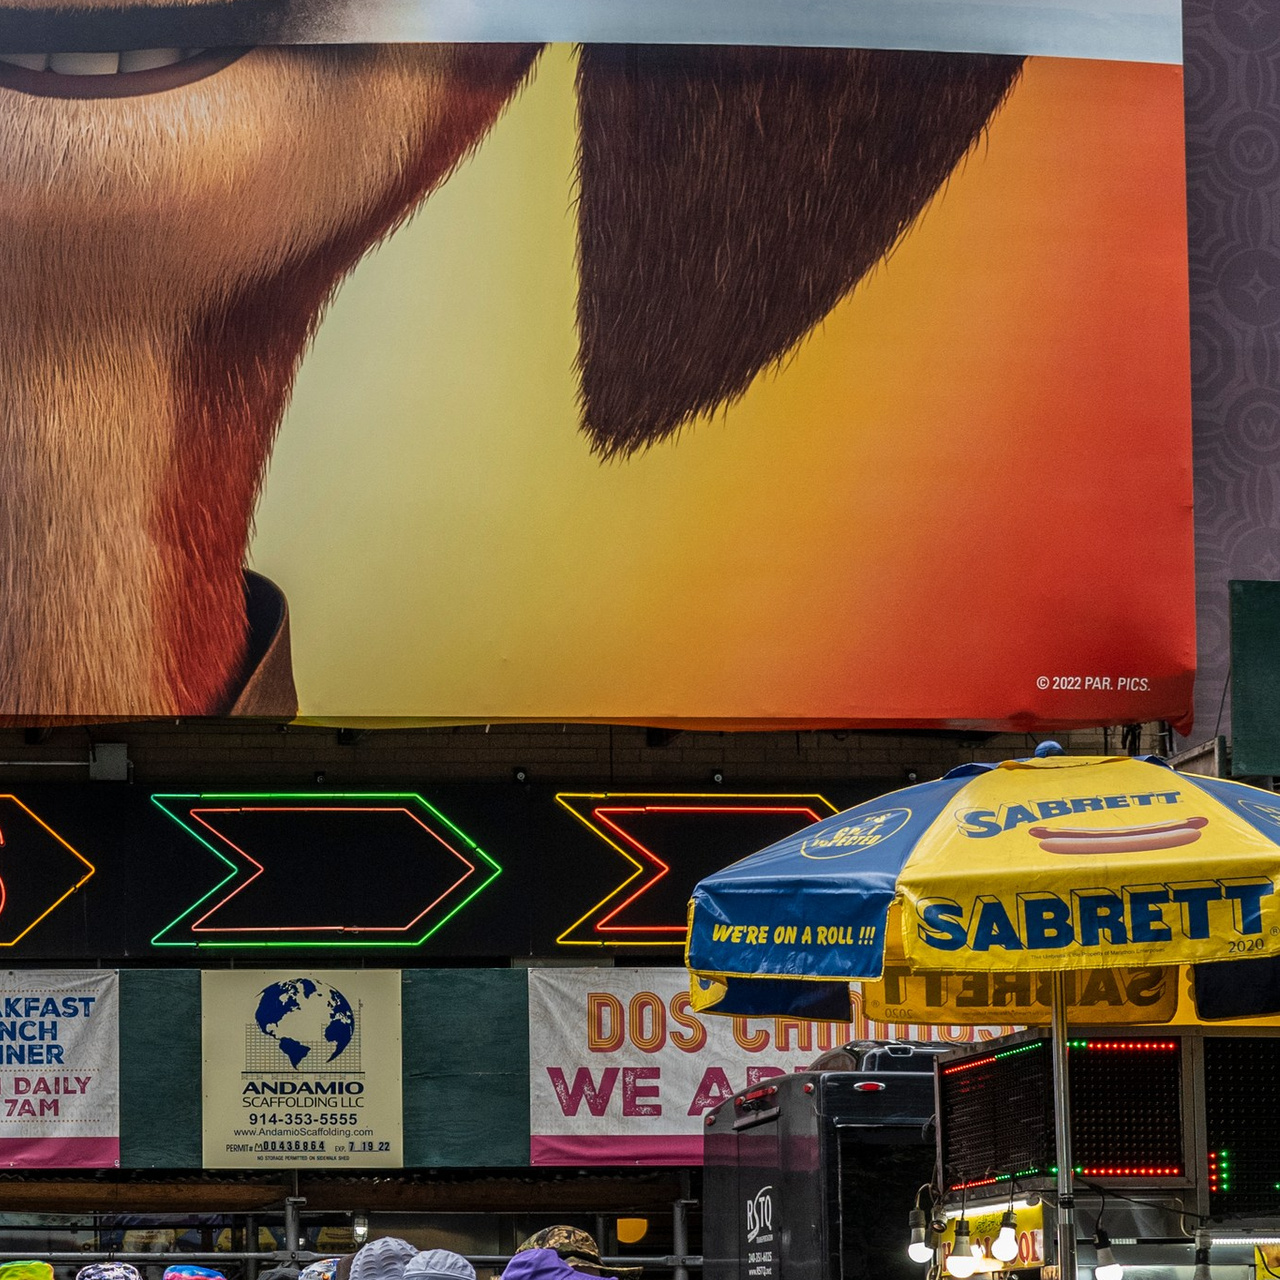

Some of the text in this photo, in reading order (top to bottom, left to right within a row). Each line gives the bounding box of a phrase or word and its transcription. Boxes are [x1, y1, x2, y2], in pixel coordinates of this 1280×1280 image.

[1052, 676, 1081, 690] 2022
[1084, 676, 1113, 690] PAR.
[1117, 677, 1151, 691] PICS.
[954, 791, 1182, 839] SABRETT
[916, 876, 1275, 953] SABRETT
[712, 924, 876, 946] WE'RE ON A ROLL !!!
[1228, 938, 1265, 953] 2020
[587, 991, 707, 1053] DOS
[14, 1075, 92, 1096] DAILY
[242, 1081, 365, 1095] ANDAMIO
[546, 1066, 662, 1117] WE
[5, 1098, 60, 1117] 7AM
[242, 1096, 365, 1108] SCAFFOLDING LLC
[249, 1113, 358, 1125] 914-353-5555
[234, 1127, 374, 1138] www.AndamioScaffolding.com
[226, 1143, 253, 1152] PERMIT#
[348, 1141, 355, 1151] 7
[378, 1141, 390, 1151] 22
